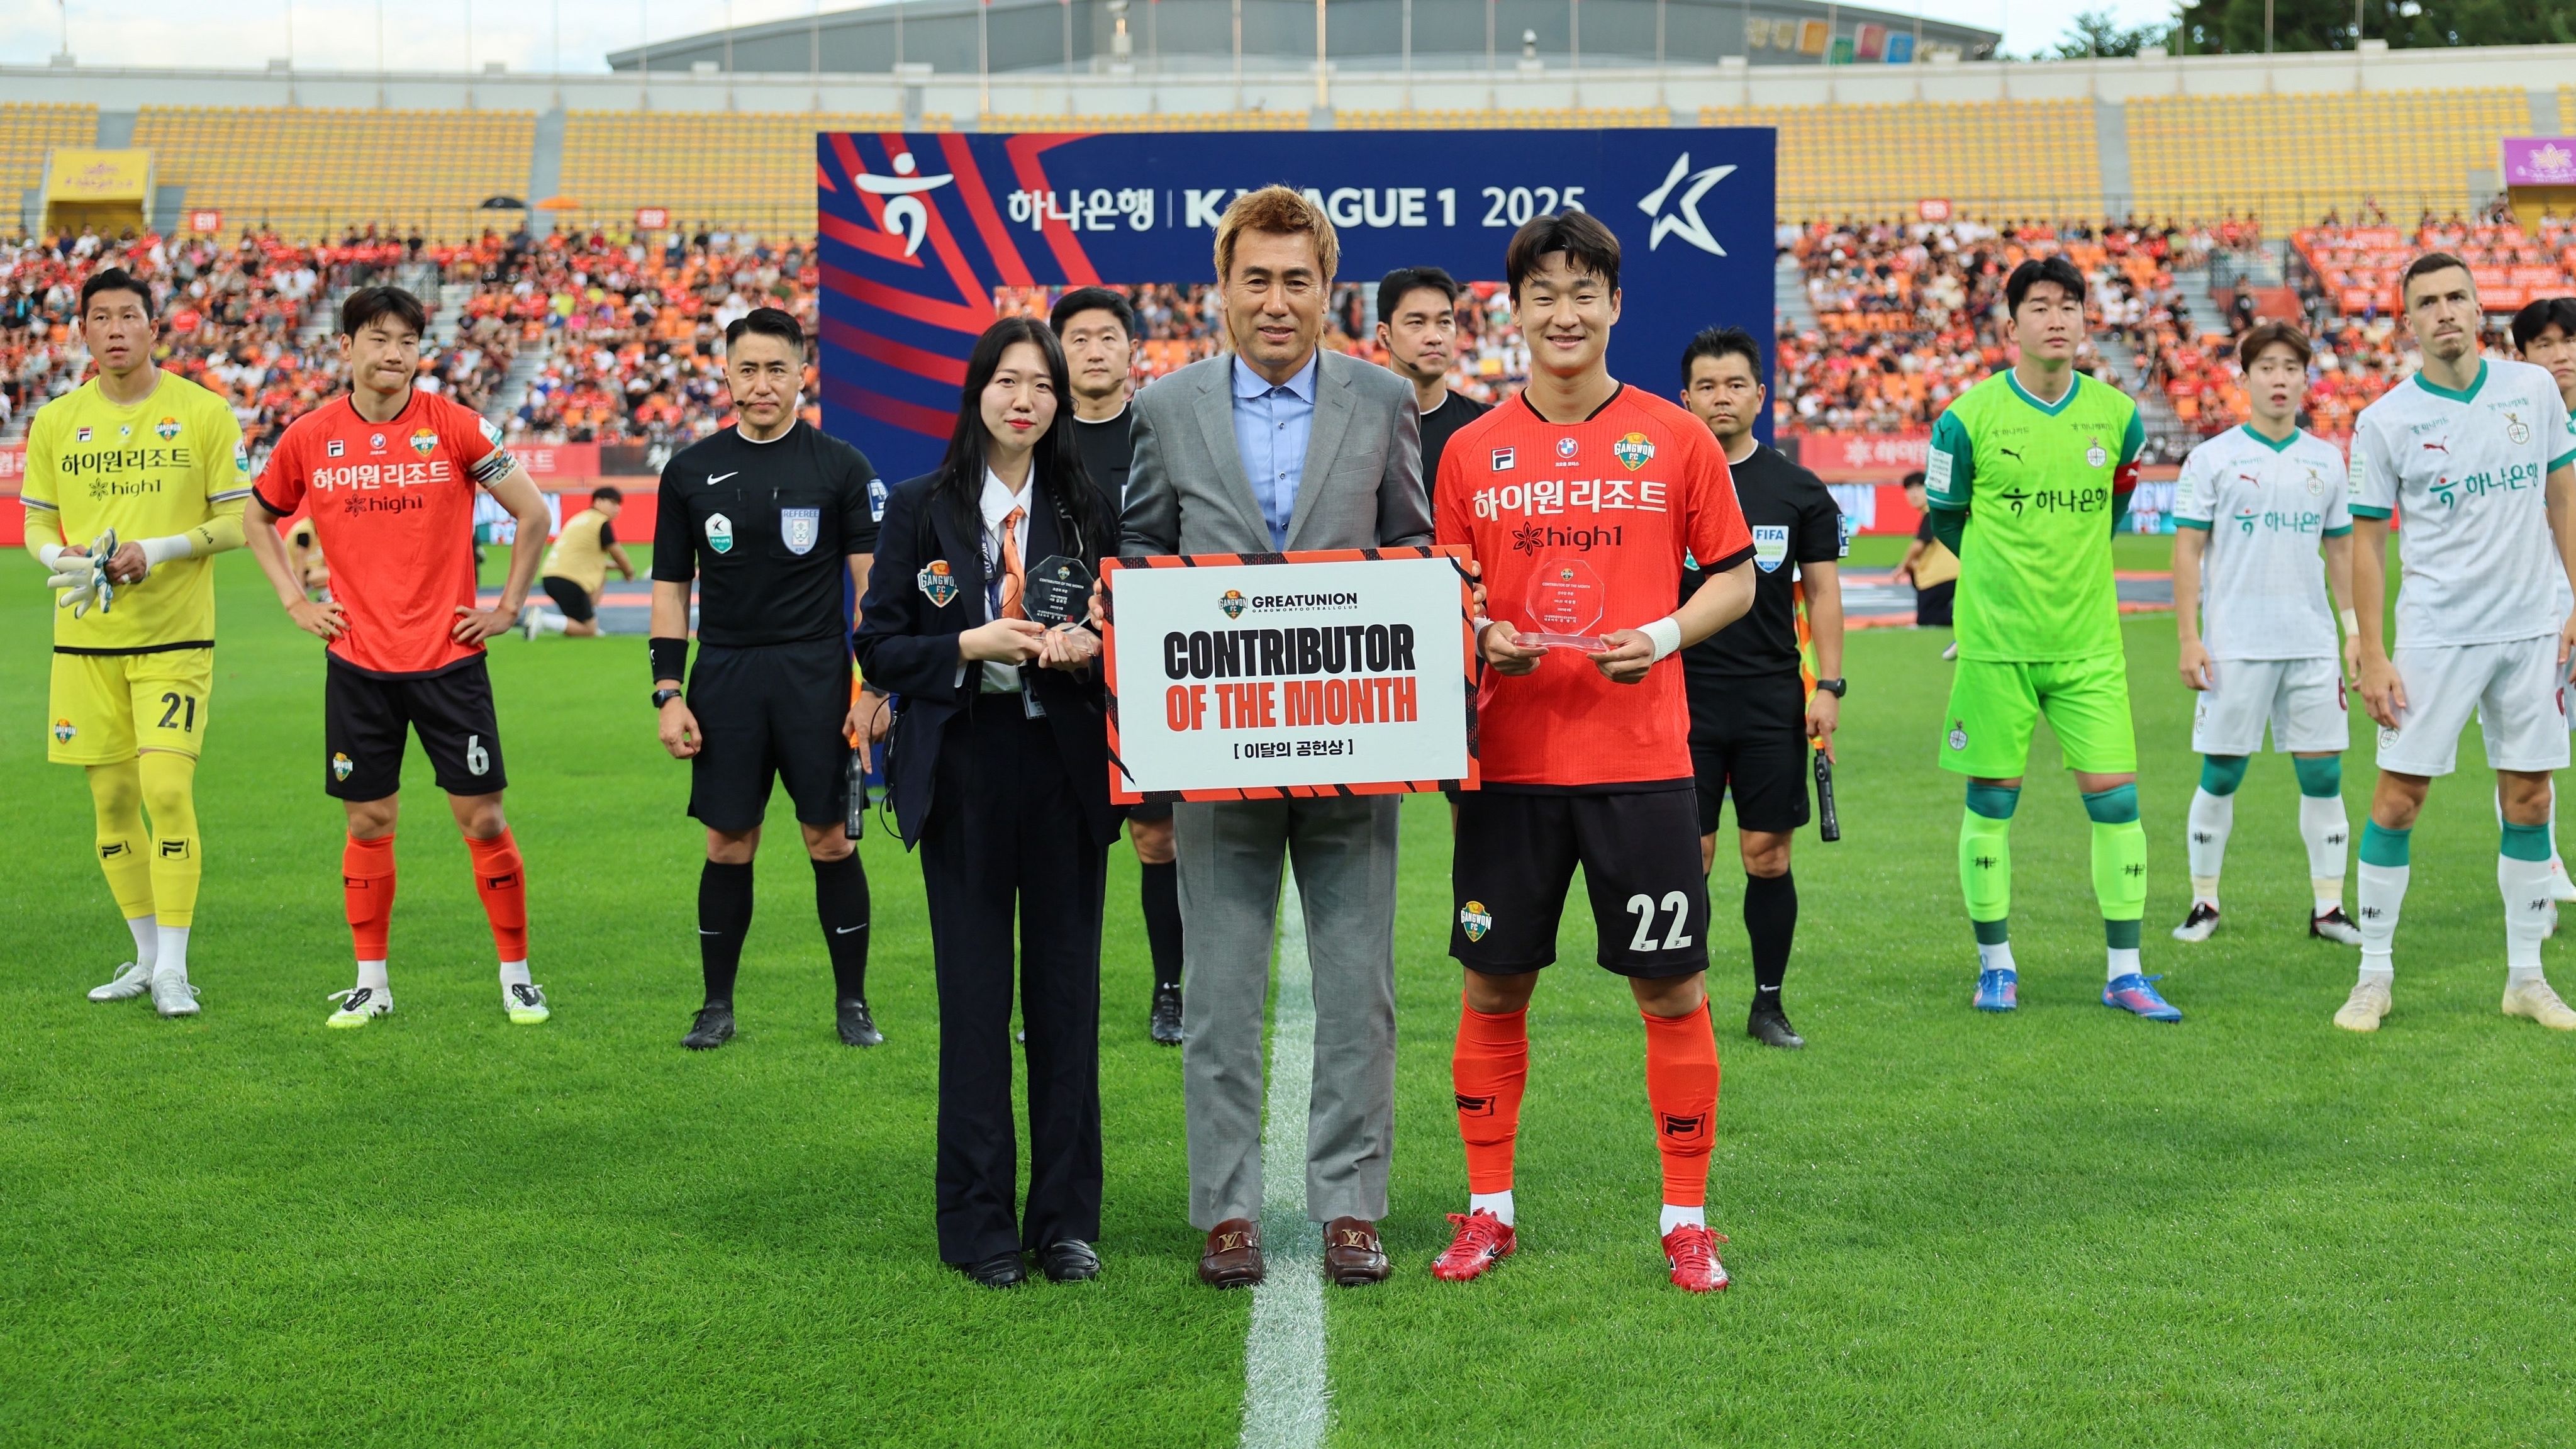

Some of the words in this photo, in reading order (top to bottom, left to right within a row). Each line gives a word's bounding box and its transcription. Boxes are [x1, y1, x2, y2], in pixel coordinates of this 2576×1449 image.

[1008, 188, 1155, 232] 하나은행
[1437, 188, 1456, 227] 1
[1614, 443, 1655, 459] GANGWON
[112, 479, 161, 498] high1
[369, 495, 423, 514] high1
[783, 510, 819, 518] REFEREE
[1547, 525, 1622, 552] high1
[1756, 530, 1784, 540] FIFA
[920, 573, 957, 588] GANGWO
[1218, 597, 1248, 609] GANGWON
[1252, 593, 1357, 608] GREATUNION
[1164, 624, 1416, 680] CONTRIBUTOR
[157, 692, 196, 732] 21
[1165, 684, 1207, 732] OF
[1215, 681, 1276, 729] THE
[1284, 676, 1418, 727] MONTH
[467, 735, 489, 776] 6
[1244, 741, 1291, 759] 이달의
[1296, 739, 1344, 757] 공헌상
[1461, 910, 1492, 930] GANGWON
[1471, 922, 1478, 931] FC
[1627, 890, 1692, 951] 22
